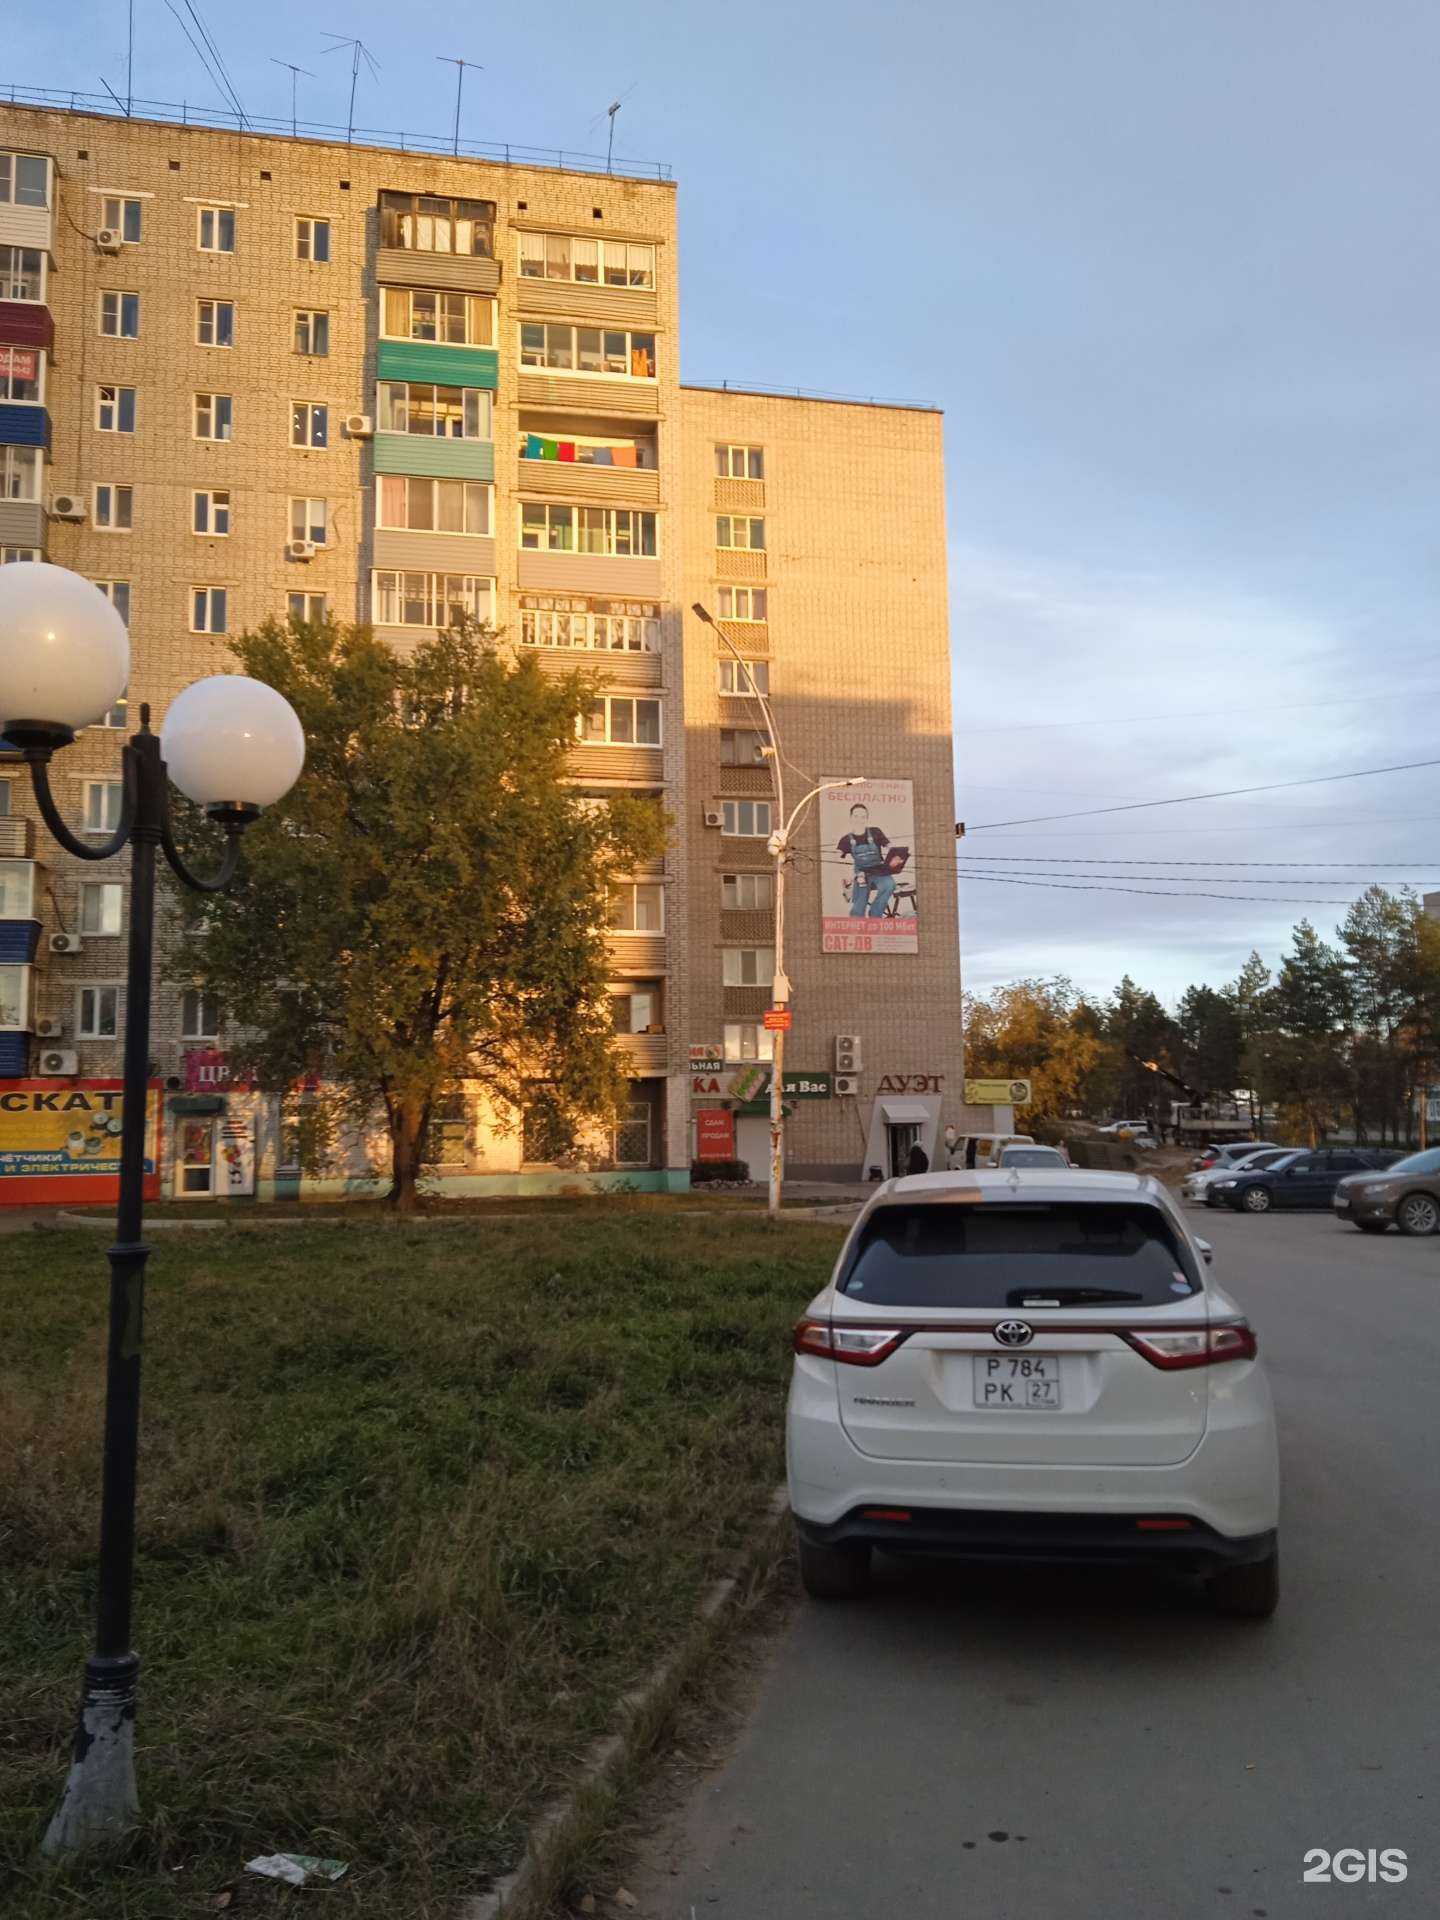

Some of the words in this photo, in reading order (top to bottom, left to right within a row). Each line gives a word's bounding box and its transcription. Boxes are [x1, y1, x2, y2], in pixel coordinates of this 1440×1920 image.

[828, 791, 906, 803] БЕСПЛАТНО
[799, 1081, 827, 1093] Вас
[878, 1074, 945, 1093] ДУЭТ
[0, 1092, 122, 1112] СКАТ
[987, 1359, 1000, 1377] Р
[1007, 1359, 1046, 1378] 784
[984, 1382, 1014, 1402] РК
[1032, 1383, 1051, 1399] 27
